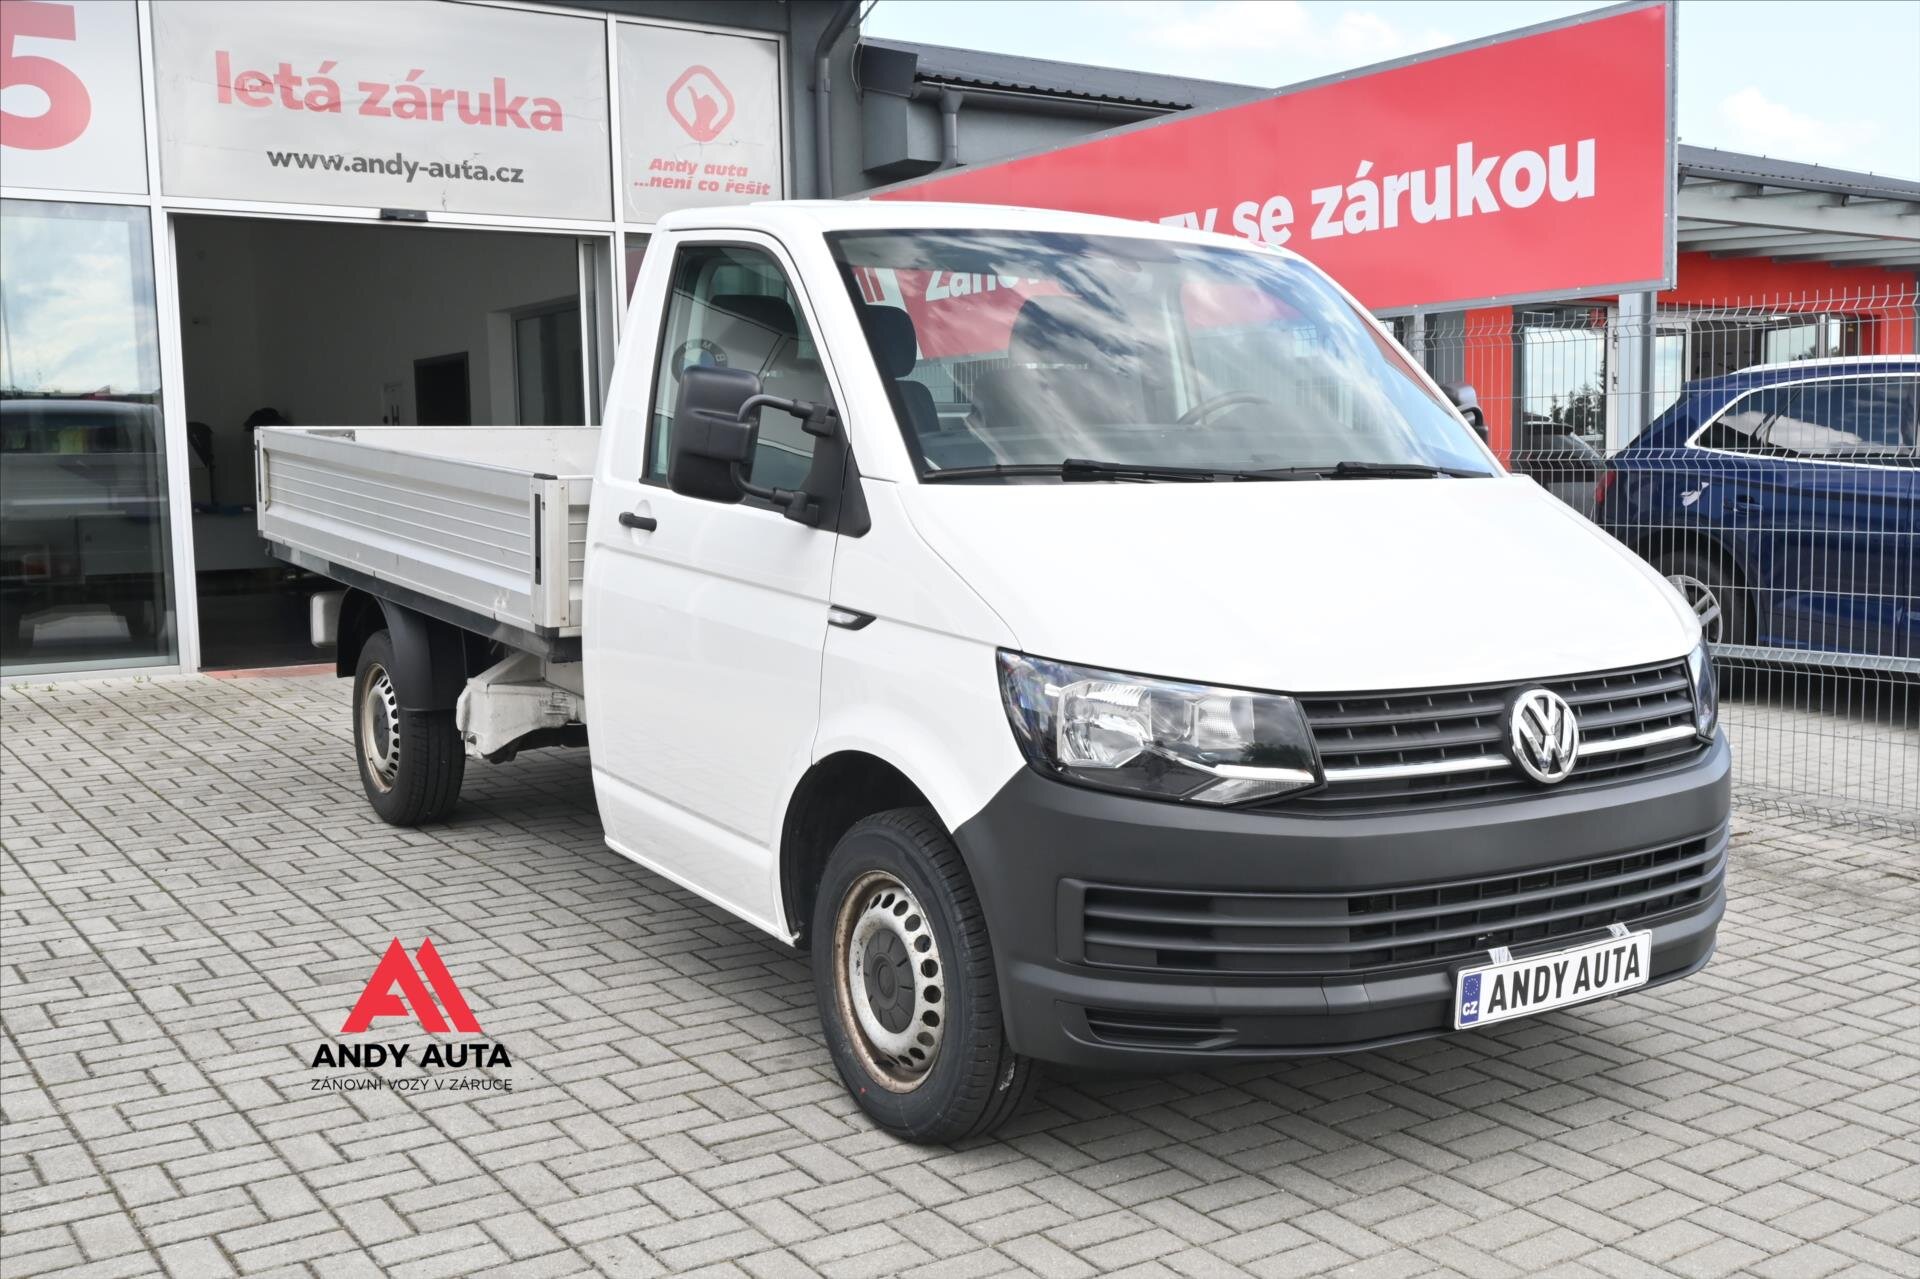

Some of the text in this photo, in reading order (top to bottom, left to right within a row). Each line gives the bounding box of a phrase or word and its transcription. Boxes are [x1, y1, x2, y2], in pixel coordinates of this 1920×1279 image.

[0, 0, 92, 151] 5
[215, 50, 563, 131] letá záruka
[267, 151, 524, 183] www.andy-auta.cz
[648, 158, 748, 177] Andy auta
[698, 180, 720, 192] co
[725, 180, 770, 195] řešit
[1232, 138, 1595, 246] se zárukou
[1487, 943, 1640, 1014] ANDY AUTA
[1462, 1001, 1478, 1016] CZ
